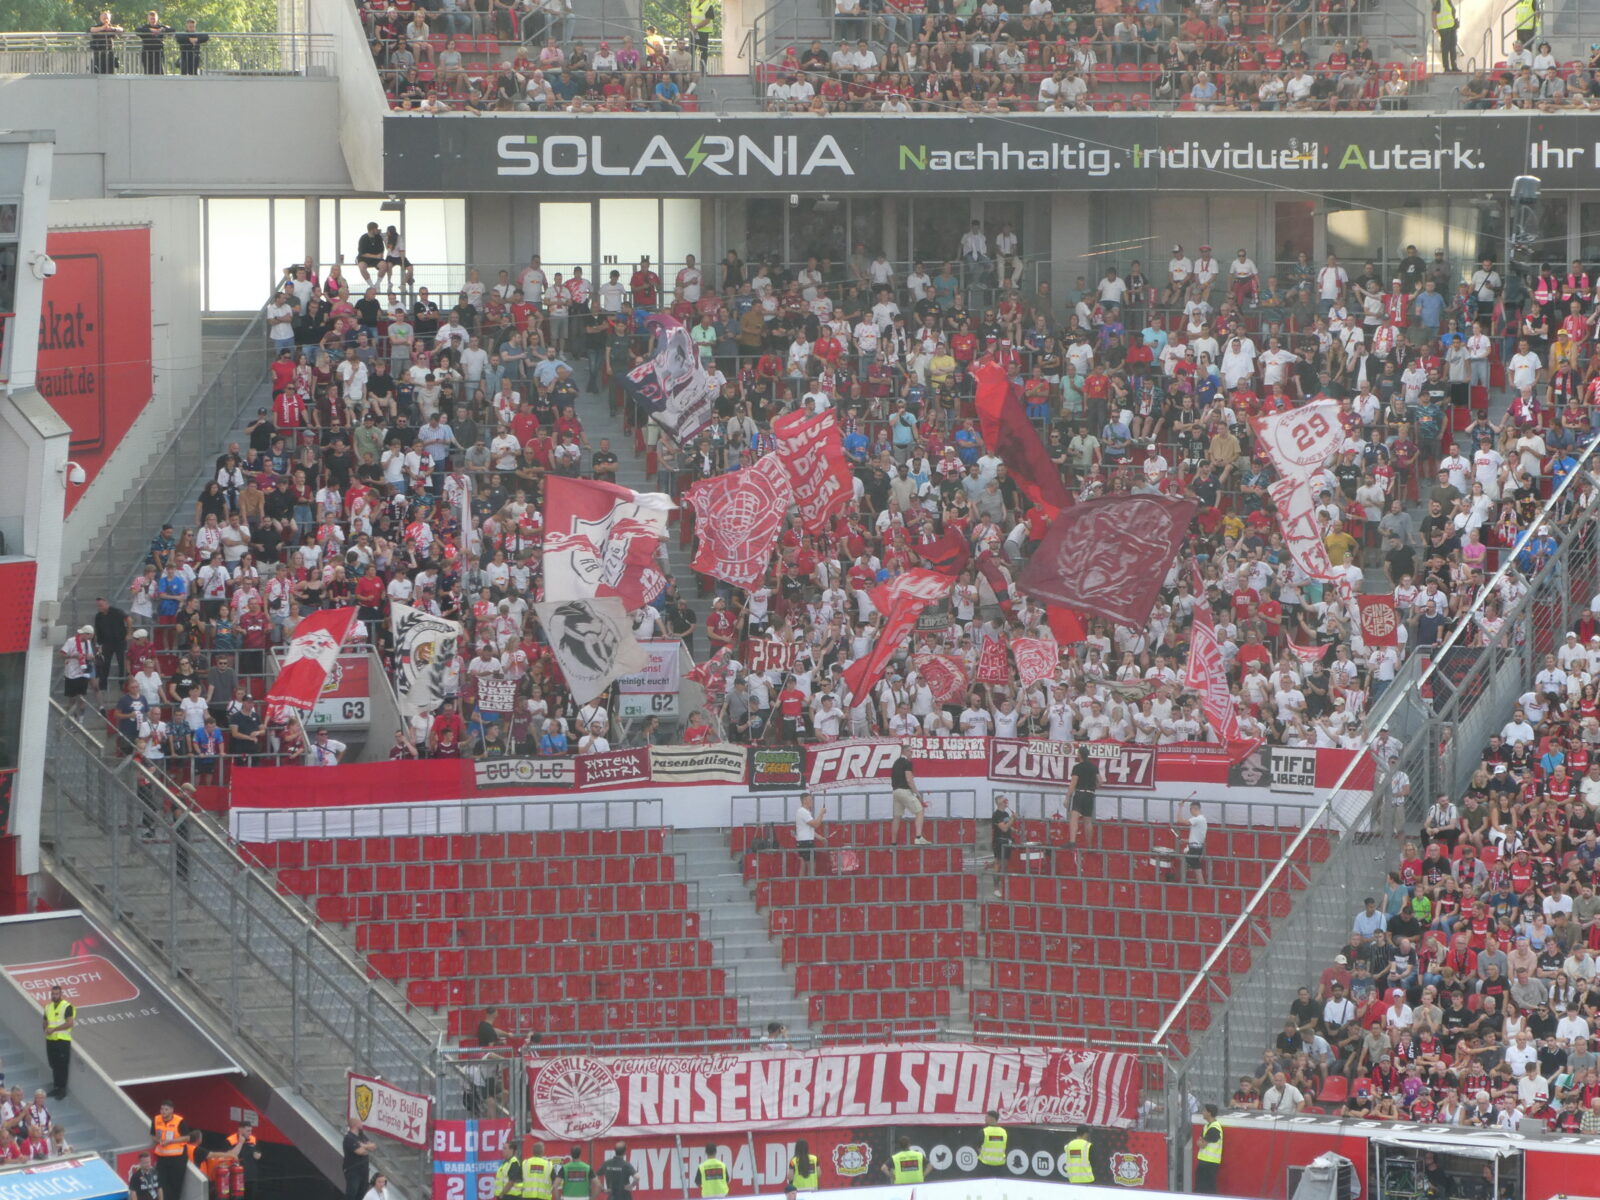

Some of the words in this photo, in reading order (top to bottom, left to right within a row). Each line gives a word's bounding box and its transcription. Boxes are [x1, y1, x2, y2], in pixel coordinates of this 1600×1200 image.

[497, 134, 855, 176] SOLARNIA
[899, 142, 1121, 177] Nachhaltig.
[1132, 142, 1328, 170] Individuell.
[1338, 142, 1486, 169] Autark.
[1531, 142, 1584, 169] Ihr
[1292, 413, 1330, 452] 29
[343, 702, 365, 720] G3
[651, 694, 673, 712] G2
[926, 738, 939, 749] ES
[943, 738, 985, 750] KOSTET
[1028, 742, 1059, 754] ZONE
[584, 755, 640, 770] SYSTEMA
[653, 755, 741, 768] rasenballisten
[1272, 756, 1315, 771] TIFO
[587, 766, 641, 782] ALISTRA
[1271, 773, 1314, 786] LIBERO
[537, 1058, 612, 1100] RASENBALLSPORT
[628, 1050, 1051, 1125] RASENBALLSPORT
[1227, 1111, 1452, 1134] CASTORE
[434, 1128, 512, 1152] BLOCK
[447, 1176, 496, 1200] 29
